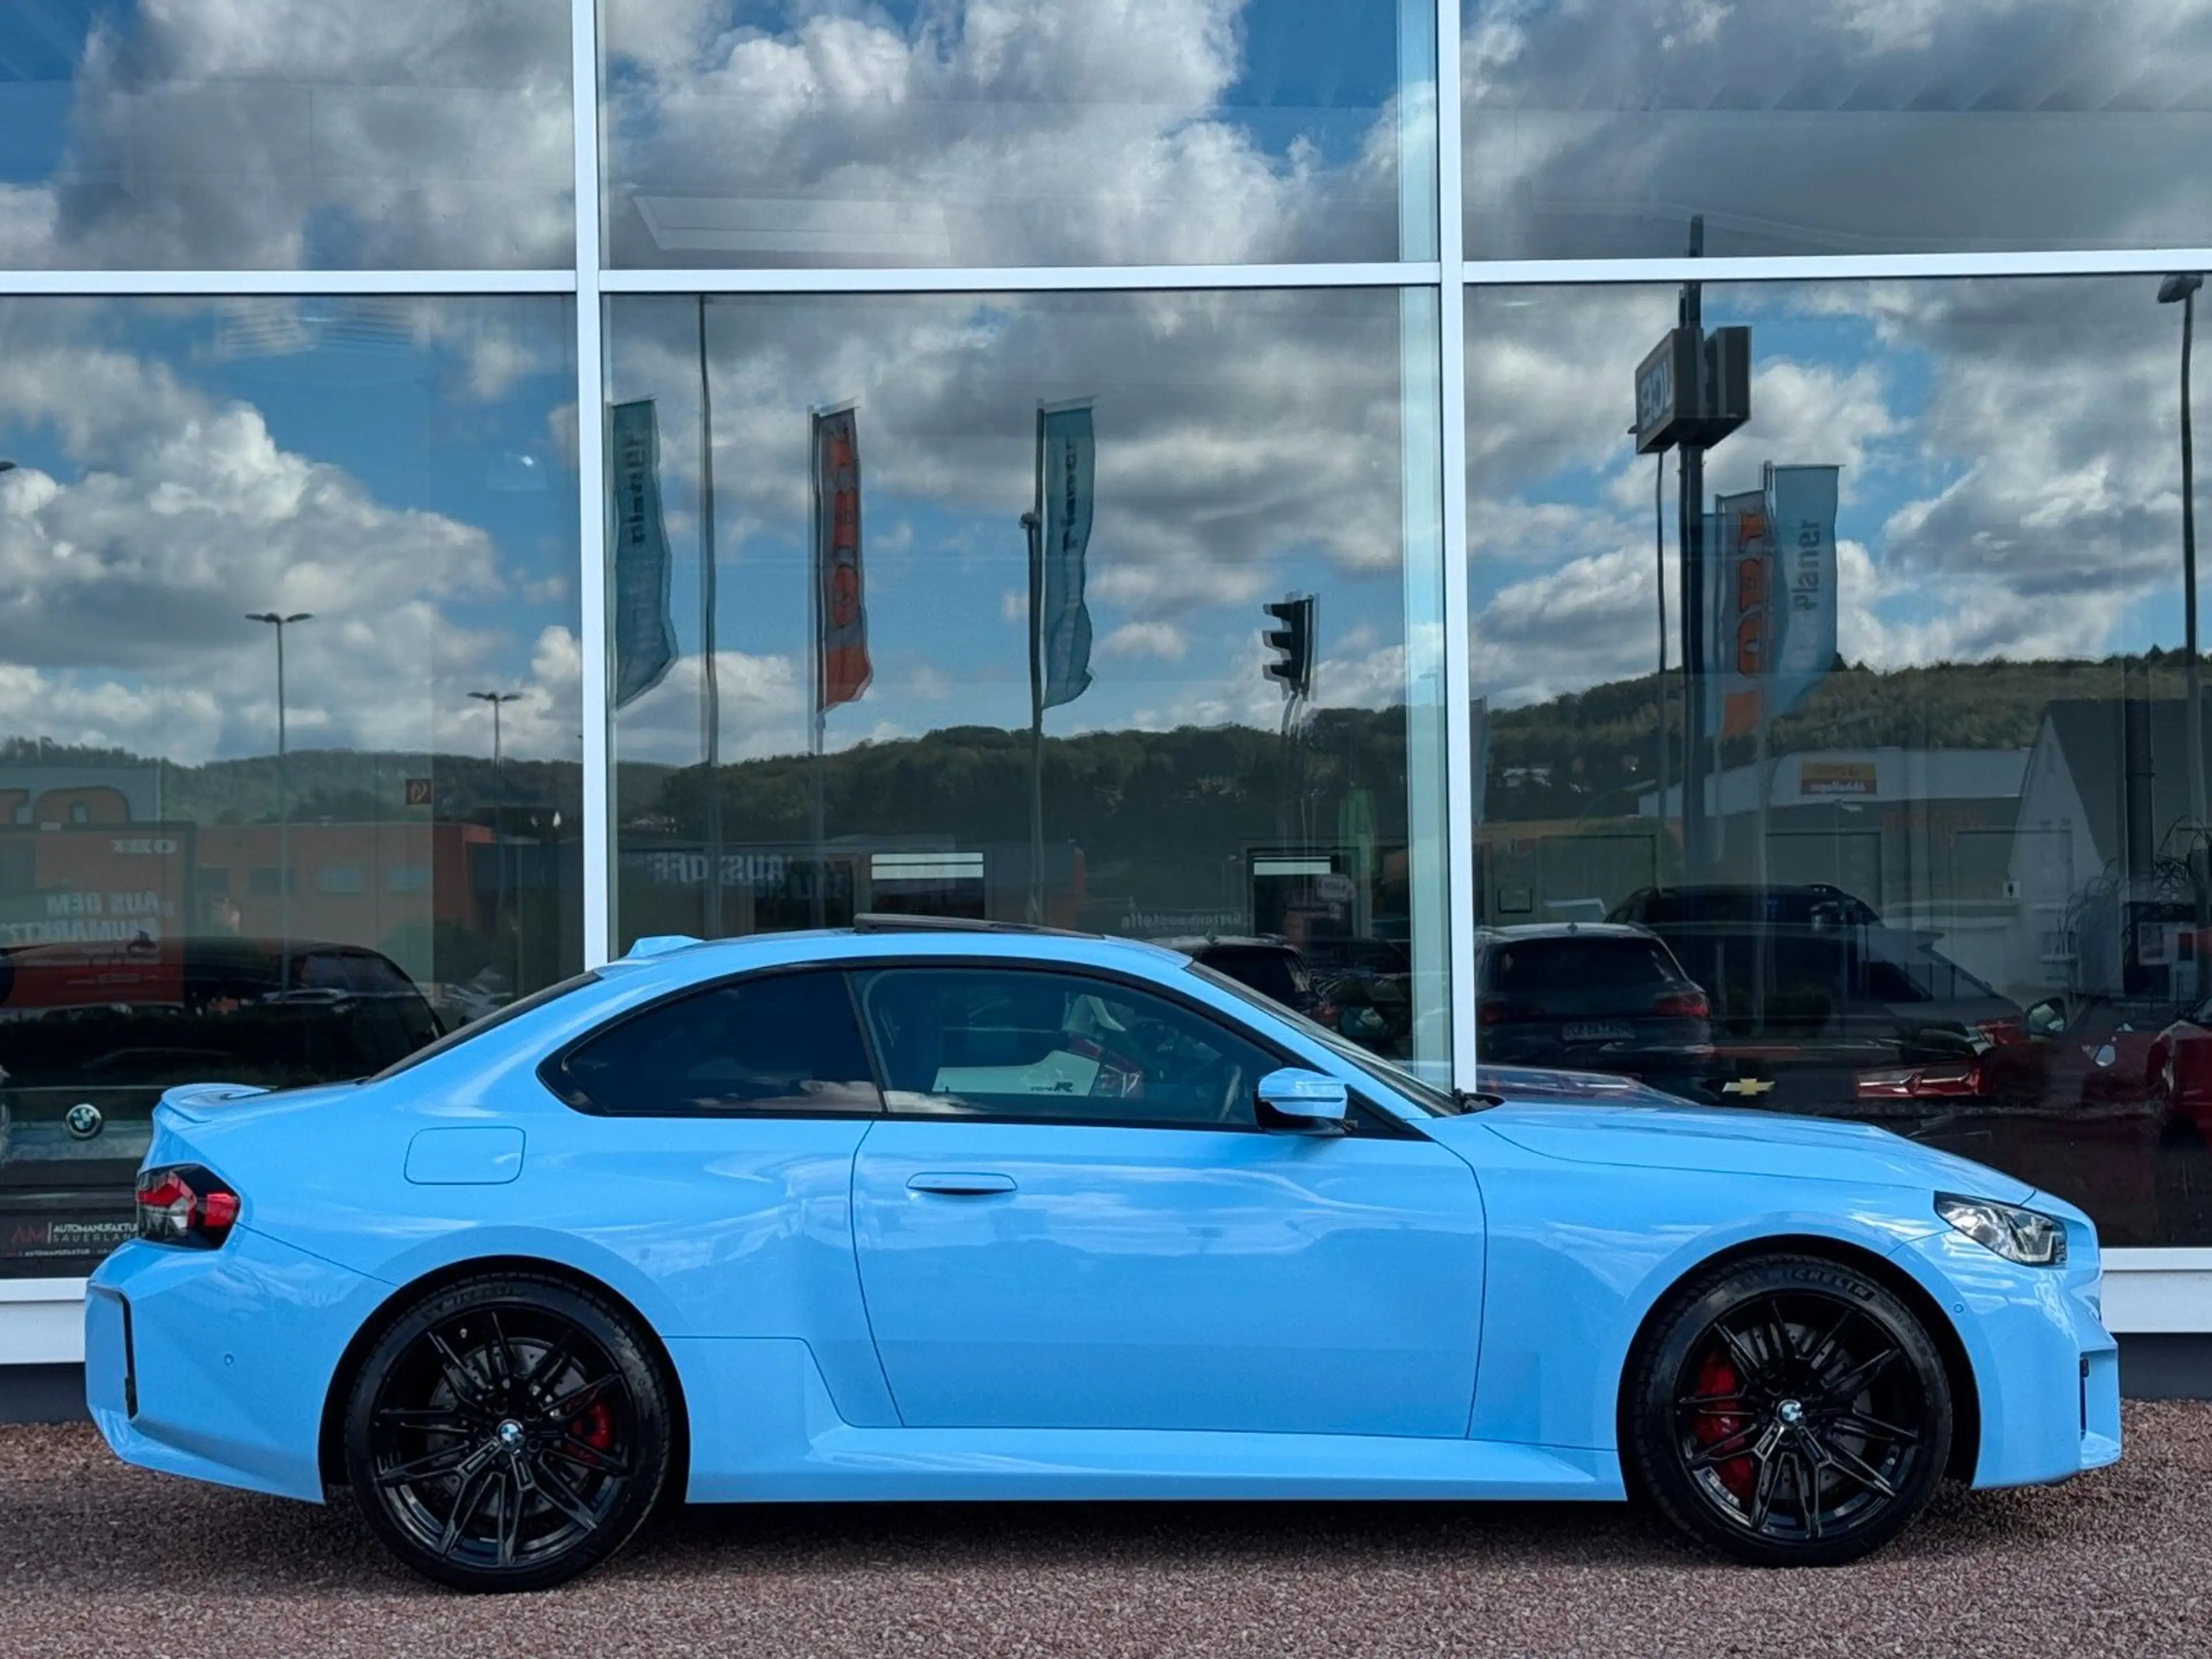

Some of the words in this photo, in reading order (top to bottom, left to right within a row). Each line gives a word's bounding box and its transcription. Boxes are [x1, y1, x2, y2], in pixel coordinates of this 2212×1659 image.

[1793, 519, 1820, 611] Planer
[54, 1224, 139, 1233] AUTOMANUFAKTU
[53, 1233, 135, 1242] SAUERLAN
